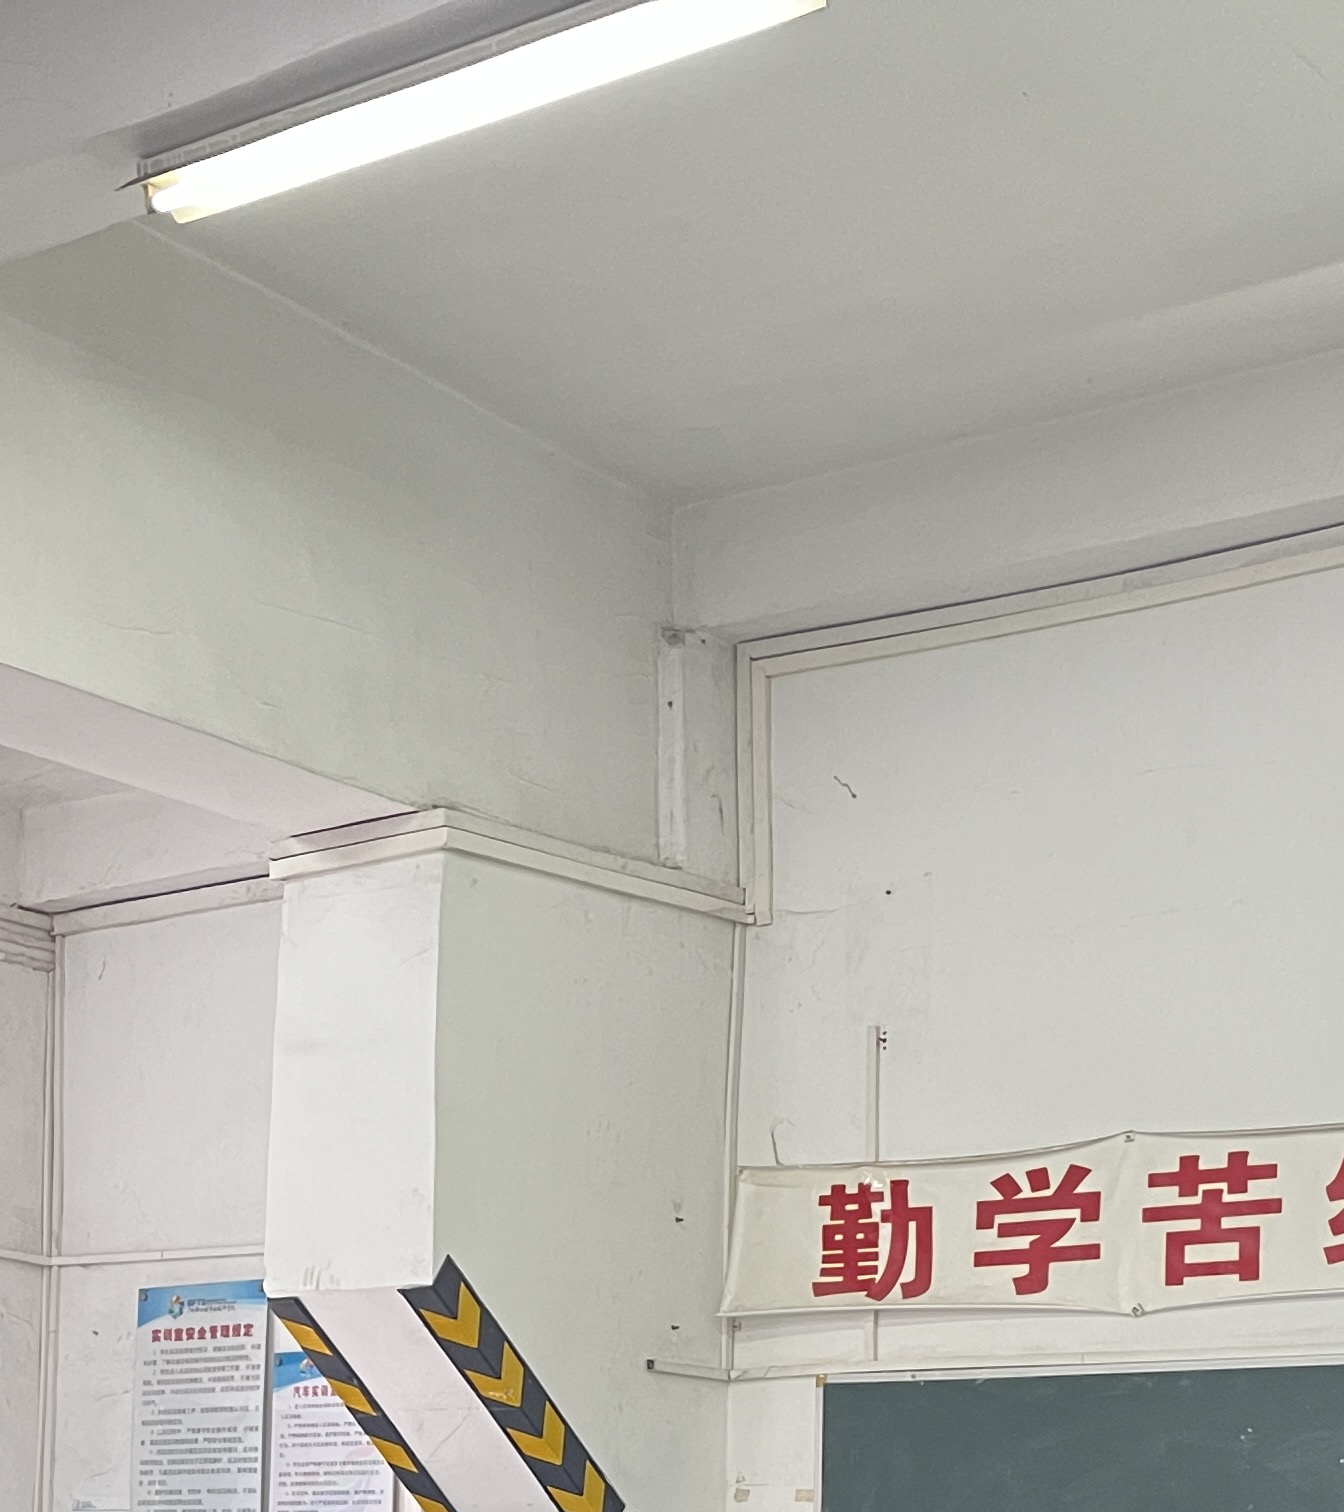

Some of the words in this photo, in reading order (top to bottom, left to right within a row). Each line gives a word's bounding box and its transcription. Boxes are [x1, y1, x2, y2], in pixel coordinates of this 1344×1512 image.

[151, 1323, 255, 1343] 实训室安全管理规定
